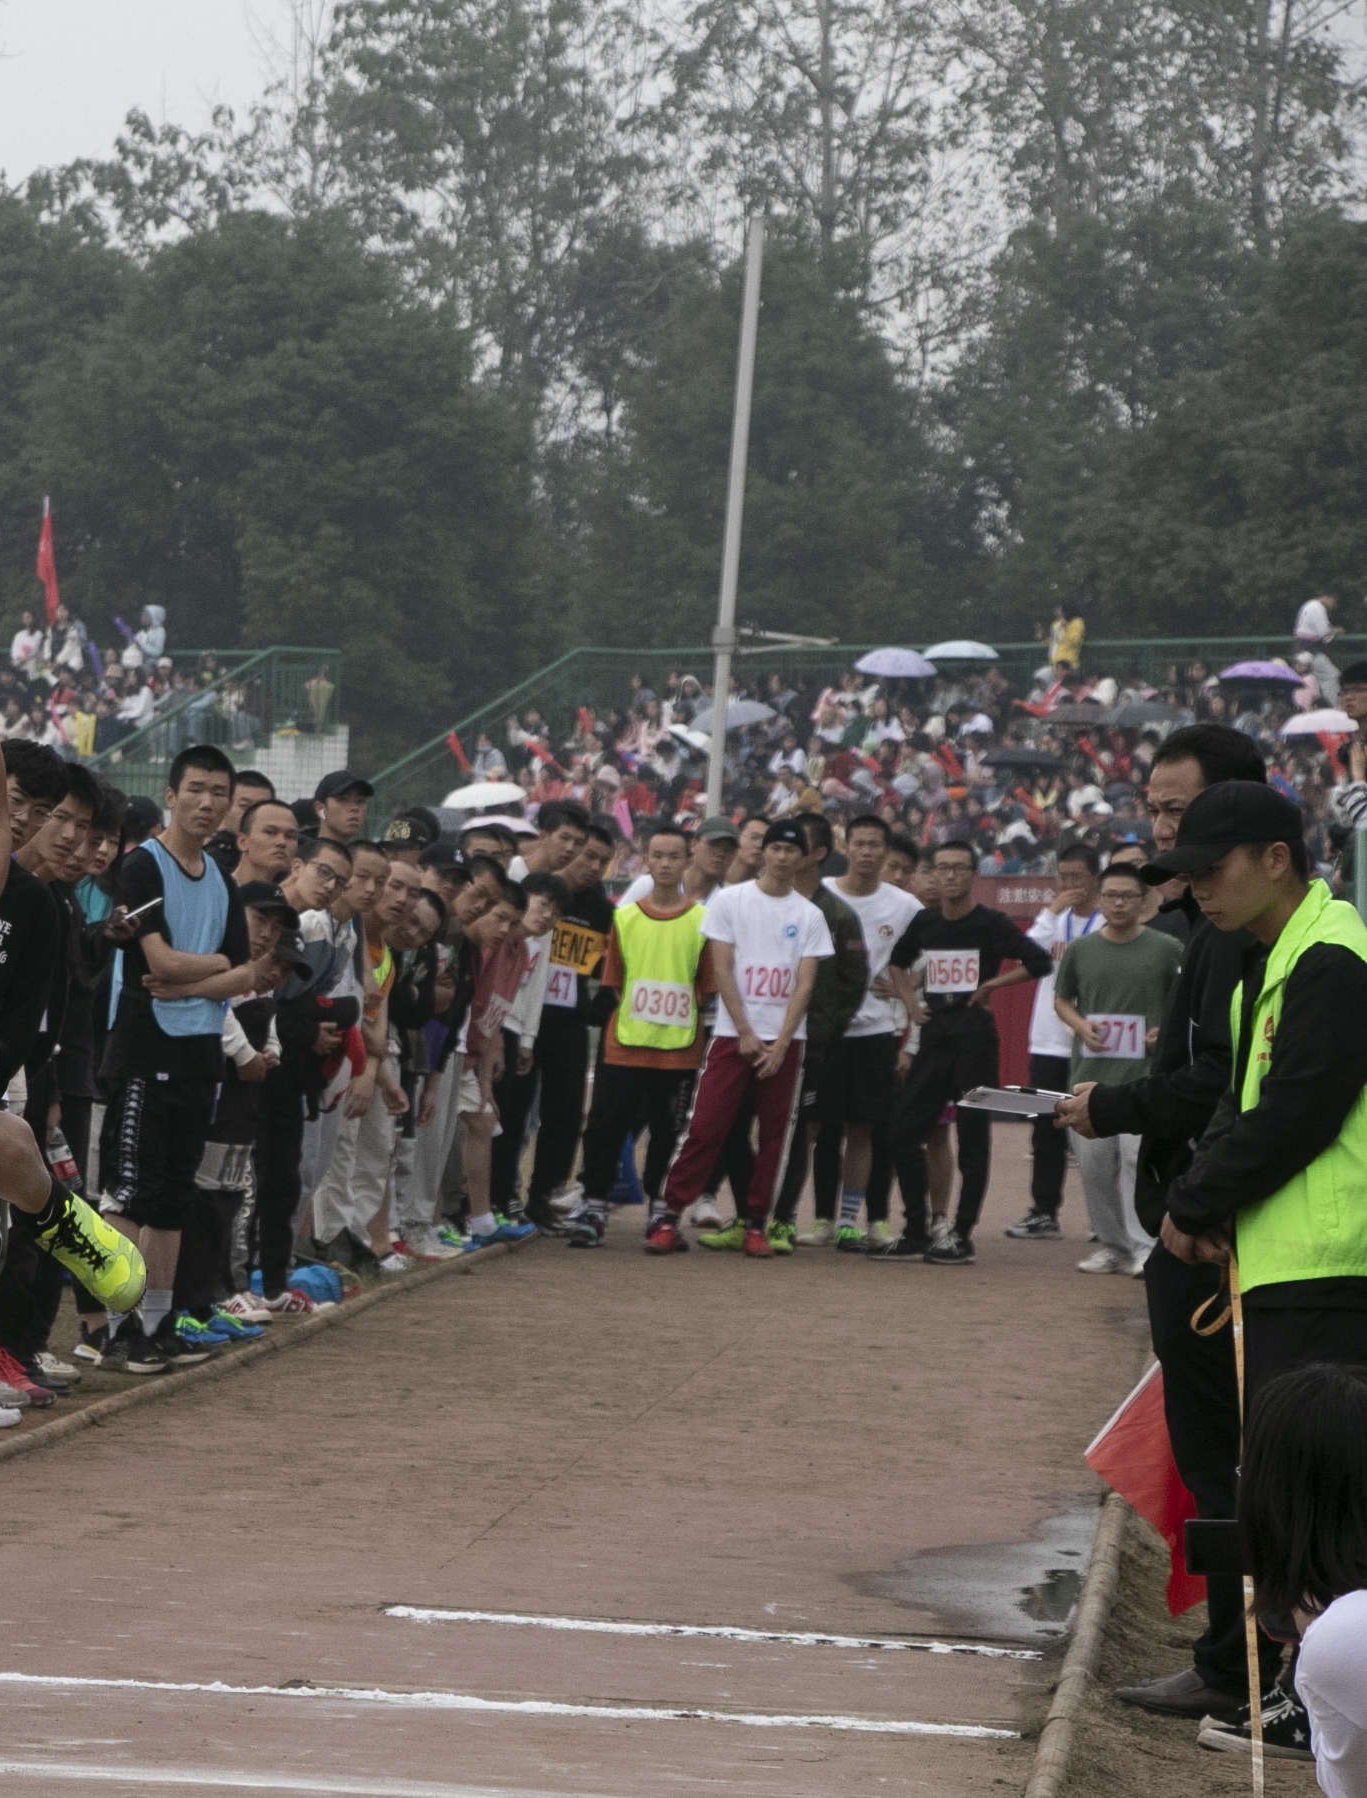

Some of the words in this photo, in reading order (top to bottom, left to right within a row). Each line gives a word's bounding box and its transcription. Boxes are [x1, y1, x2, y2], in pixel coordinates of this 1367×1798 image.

[745, 966, 792, 999] 1202
[927, 957, 978, 986] 0566
[635, 987, 691, 1019] 0303
